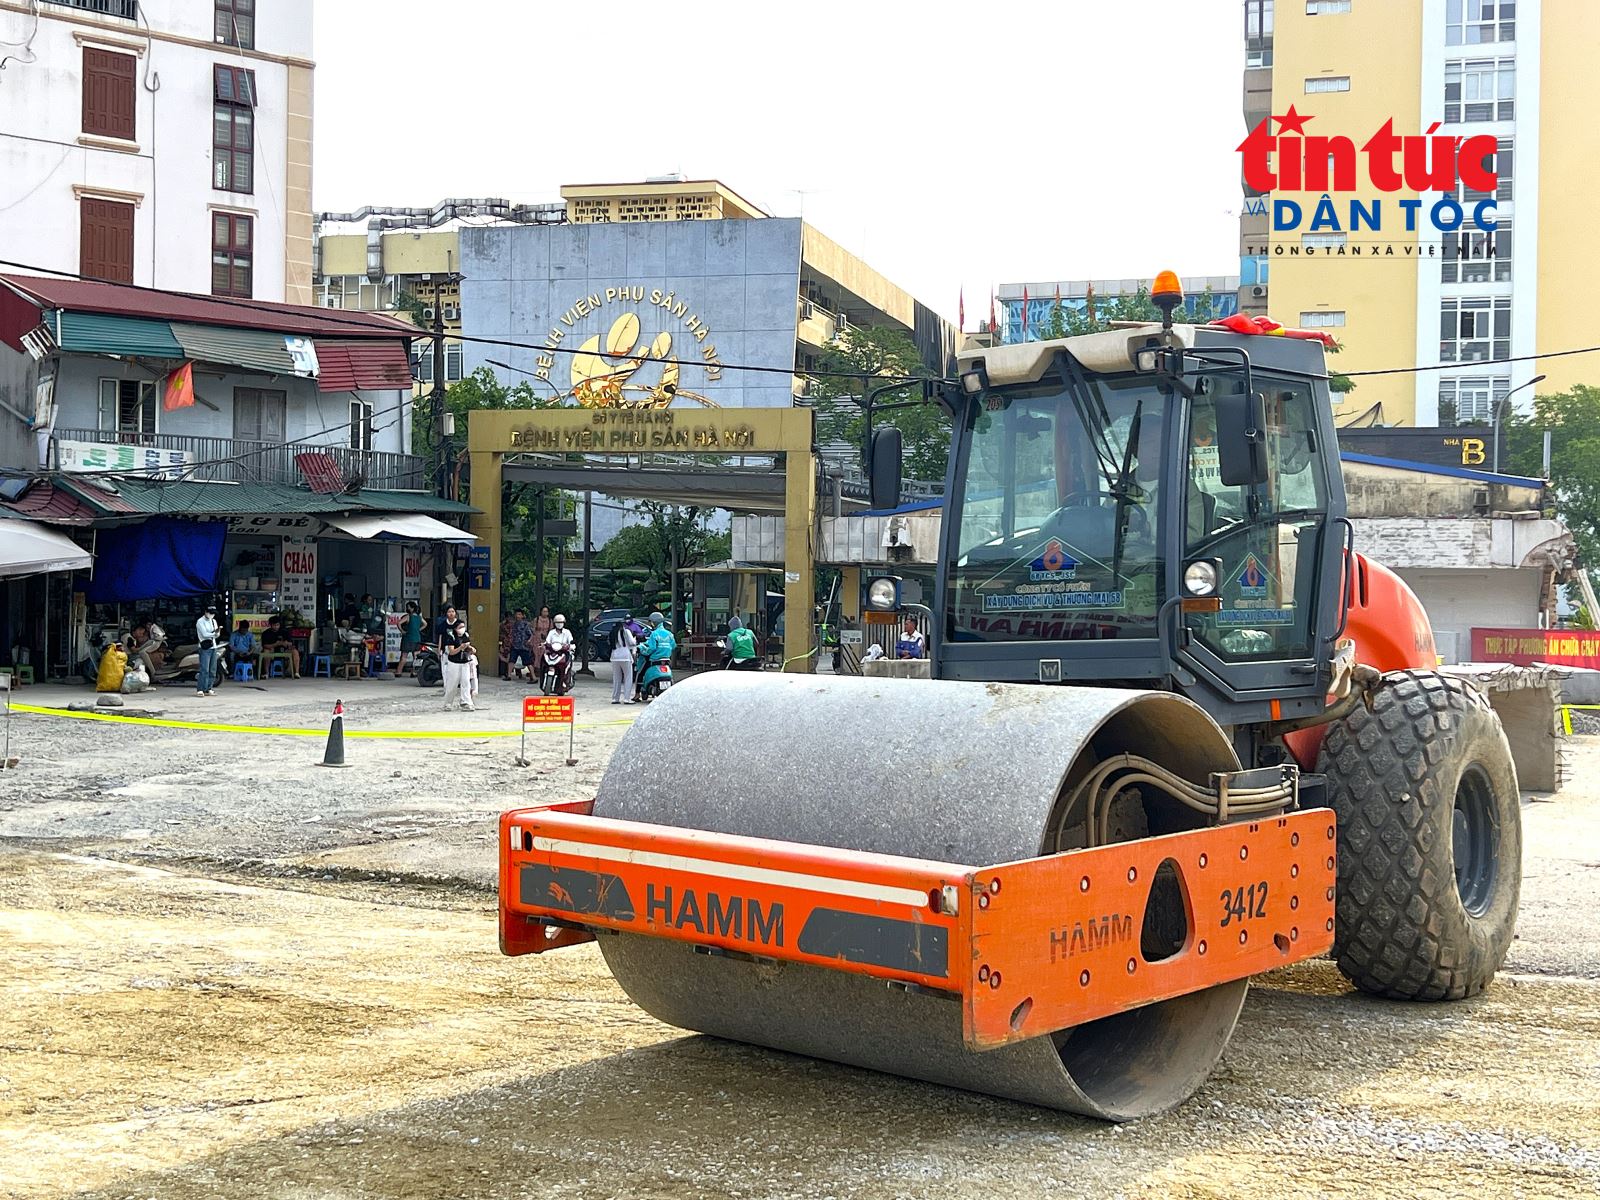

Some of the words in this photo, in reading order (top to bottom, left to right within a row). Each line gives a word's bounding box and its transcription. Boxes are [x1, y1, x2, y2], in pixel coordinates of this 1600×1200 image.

[560, 293, 602, 326] VIỆN
[605, 286, 644, 304] PHỤ
[650, 290, 688, 318] SẢN
[686, 315, 710, 343] HÀ
[511, 426, 560, 449] BỆNH
[563, 426, 605, 449] VIỆN
[694, 426, 719, 447] HÀ
[724, 426, 754, 449] NỘI
[1462, 438, 1486, 465] B
[284, 546, 315, 574] CHÁO
[475, 575, 483, 587] 1
[647, 882, 784, 947] HAMM
[1219, 880, 1269, 928] 3412
[1050, 913, 1133, 965] HAMM
